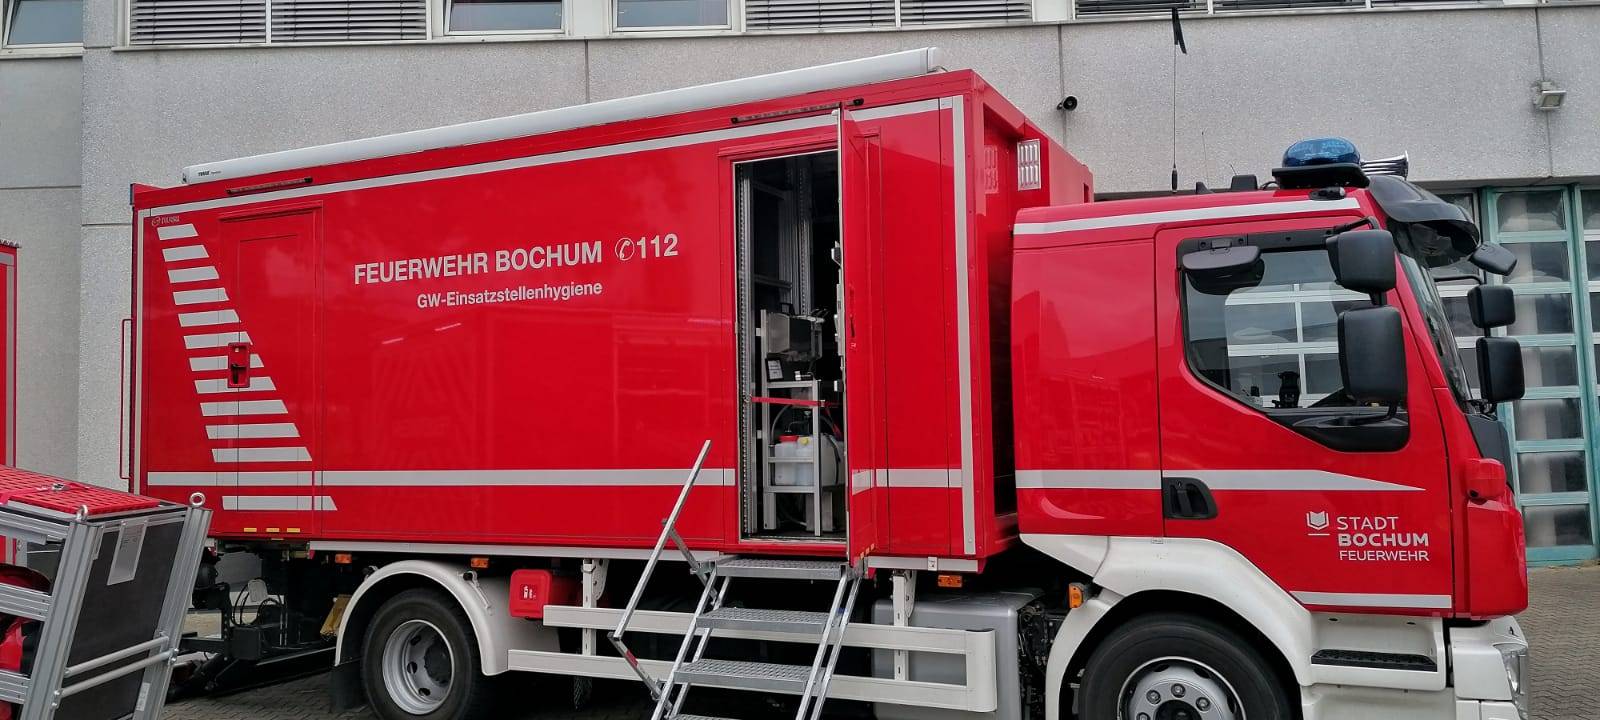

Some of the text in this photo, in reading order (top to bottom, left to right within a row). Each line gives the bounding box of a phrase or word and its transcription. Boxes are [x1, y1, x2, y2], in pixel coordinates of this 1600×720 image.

[354, 233, 679, 285] FEUERWEHR BOCHUM 112
[416, 281, 603, 309] GW-Einsatzstellenhygiene
[1336, 516, 1399, 530] STADT
[1338, 532, 1429, 547] BOCHUM
[1339, 550, 1430, 561] FEUERWEHR
